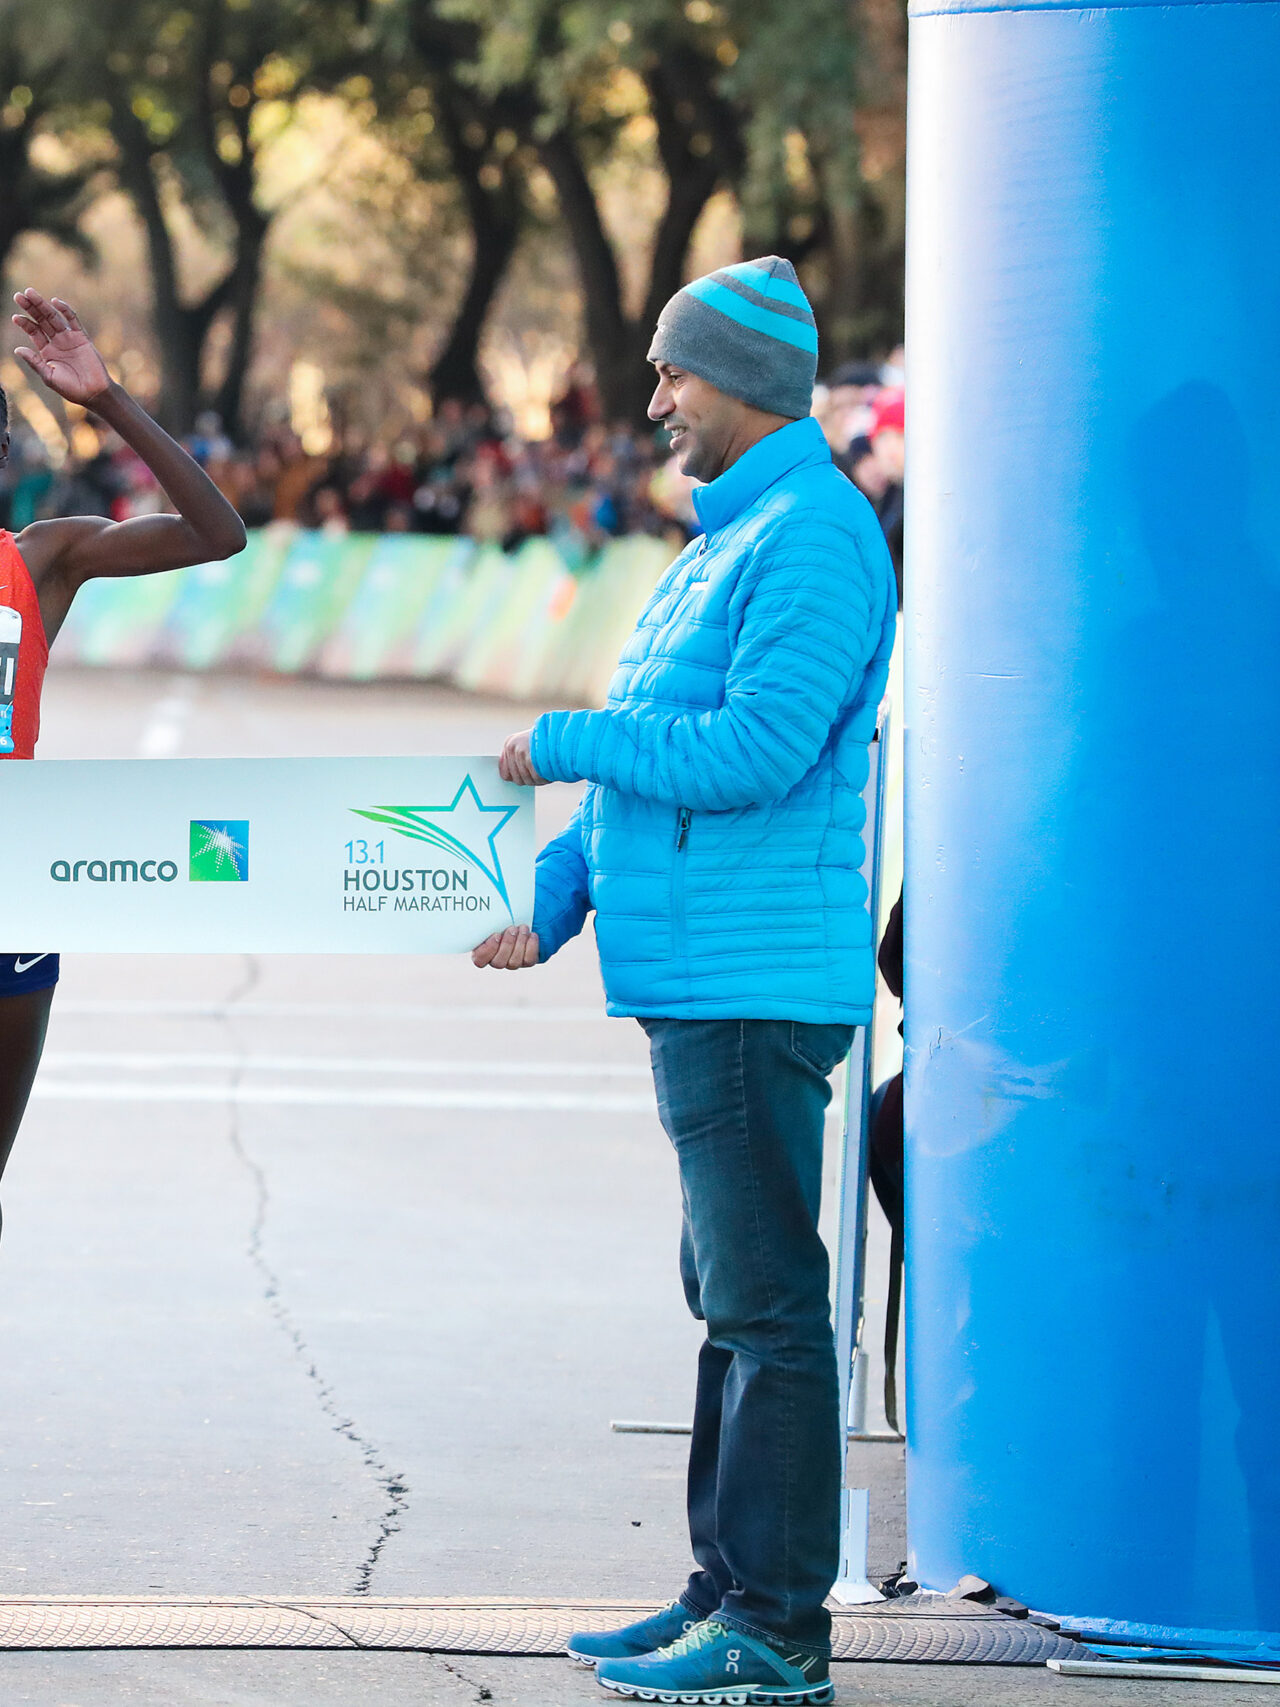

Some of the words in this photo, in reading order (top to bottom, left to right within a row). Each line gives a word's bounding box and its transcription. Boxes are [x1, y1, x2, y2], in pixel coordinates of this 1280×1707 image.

[344, 840, 385, 865] 13.1
[50, 860, 178, 882] aramco
[344, 869, 468, 892] HOUSTON
[344, 895, 388, 912] HALF
[393, 895, 491, 912] MARATHON
